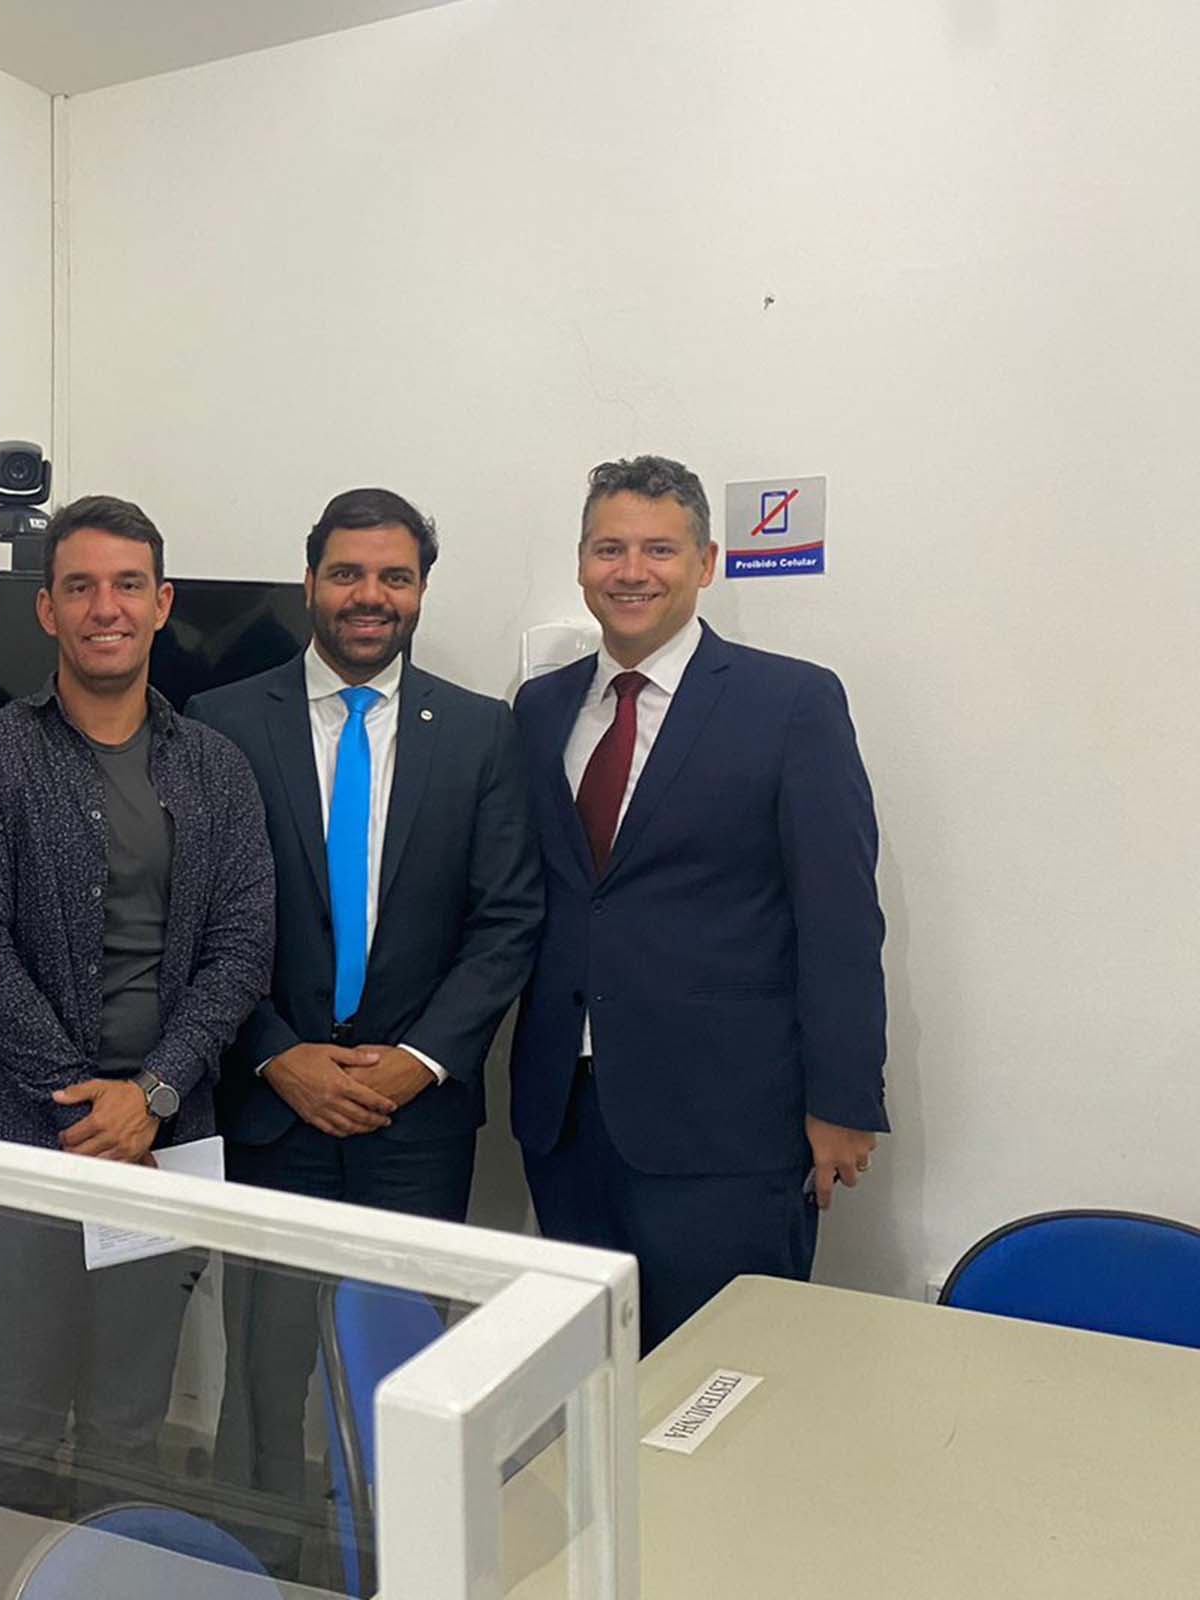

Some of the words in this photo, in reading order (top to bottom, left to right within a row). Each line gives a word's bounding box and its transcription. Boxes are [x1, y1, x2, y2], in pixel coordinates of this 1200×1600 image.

[735, 559, 777, 570] Proibido
[779, 557, 817, 568] Celular
[663, 1374, 742, 1439] TESTEMUNHA
